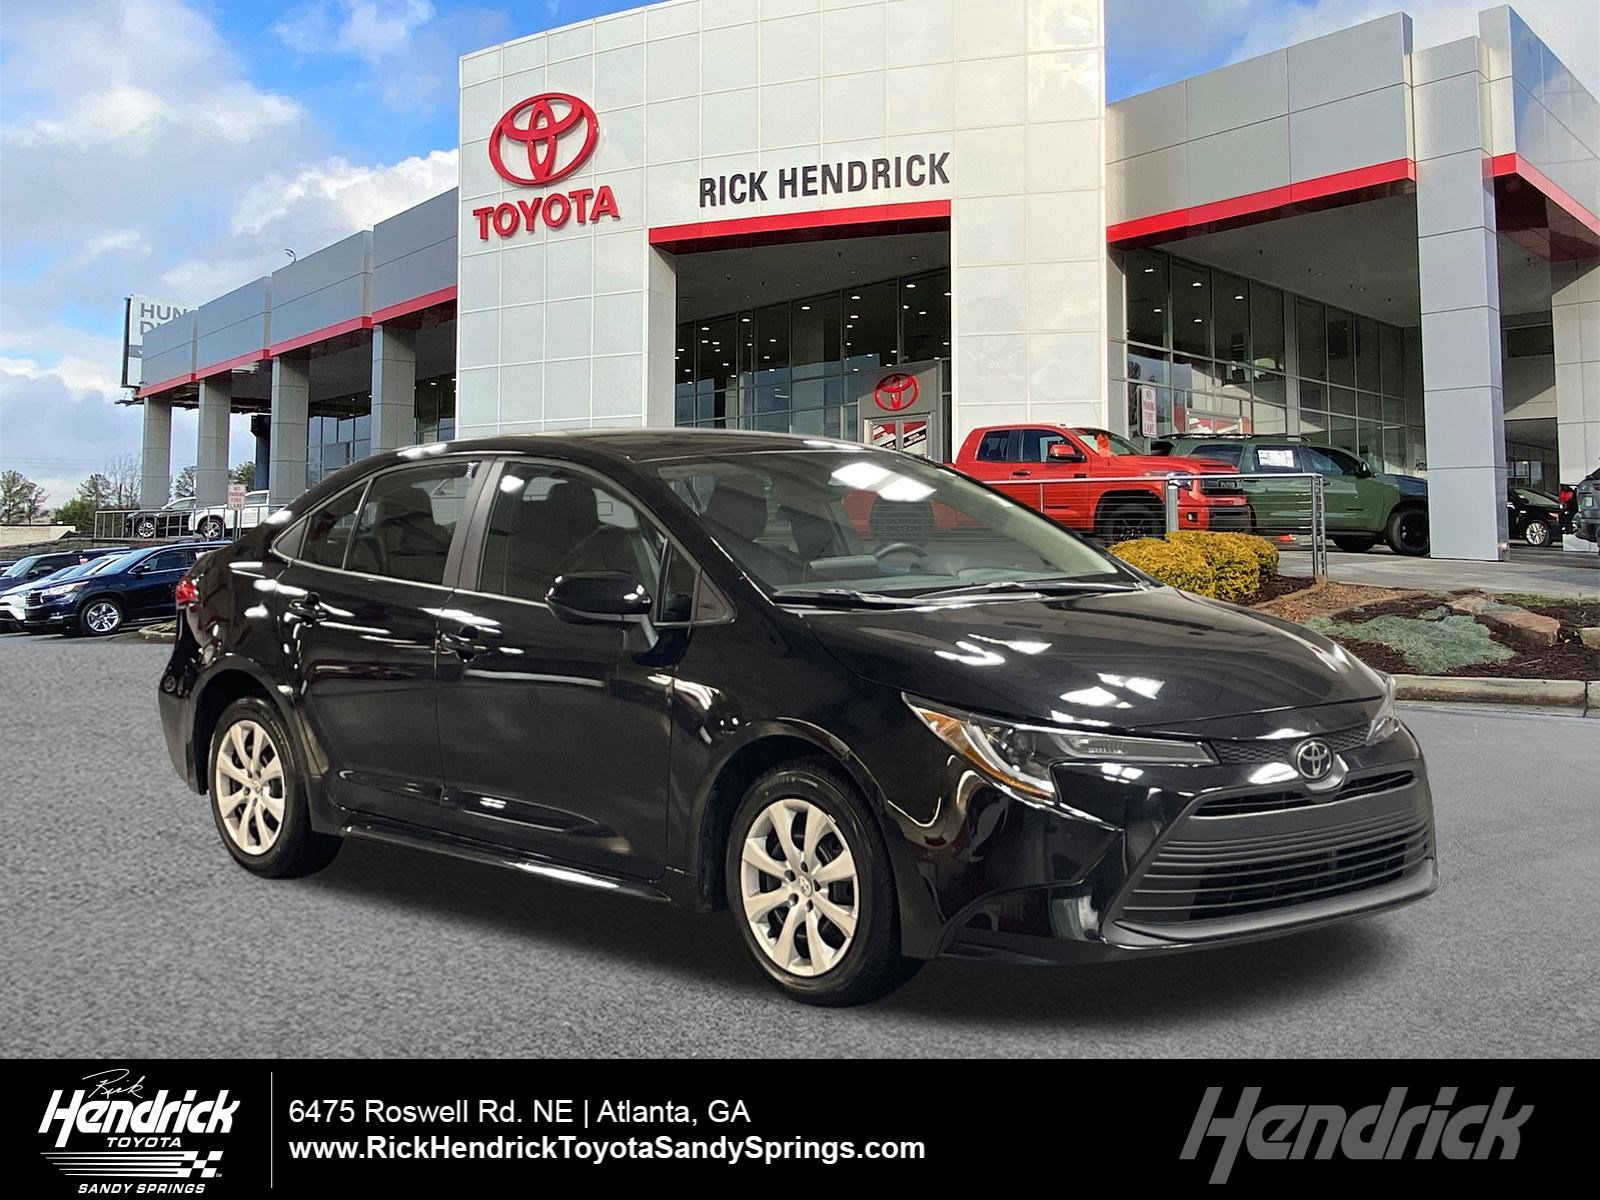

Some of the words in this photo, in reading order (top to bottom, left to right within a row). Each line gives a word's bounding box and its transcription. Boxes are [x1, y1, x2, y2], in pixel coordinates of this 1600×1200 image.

[700, 171, 768, 207] RICK
[779, 152, 950, 199] HENDRICK
[473, 185, 620, 240] TOYOTA
